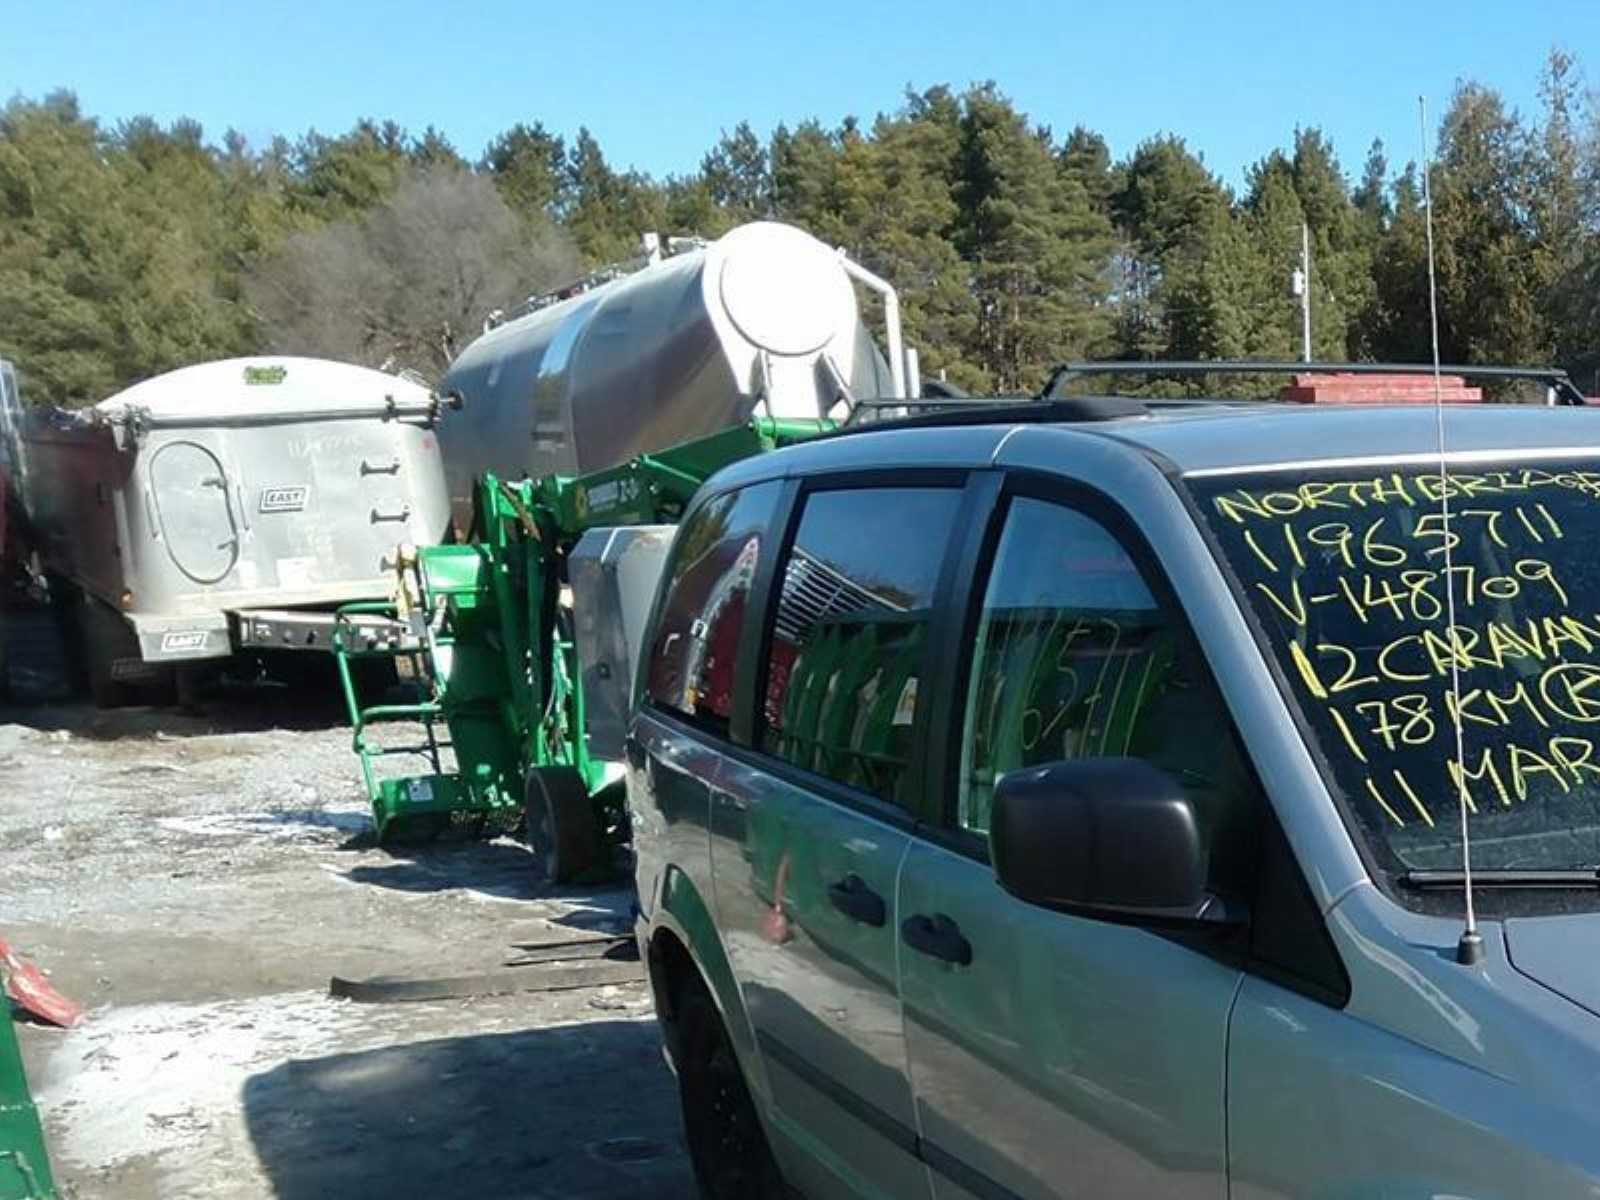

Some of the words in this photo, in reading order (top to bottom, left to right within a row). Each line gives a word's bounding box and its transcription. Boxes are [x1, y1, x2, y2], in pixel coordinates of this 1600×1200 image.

[268, 491, 301, 504] EAST
[1243, 503, 1565, 572] 11965711
[1256, 559, 1569, 626] V-148709
[1329, 694, 1436, 764] 178
[1446, 681, 1550, 729] KM
[1366, 770, 1436, 829] 11
